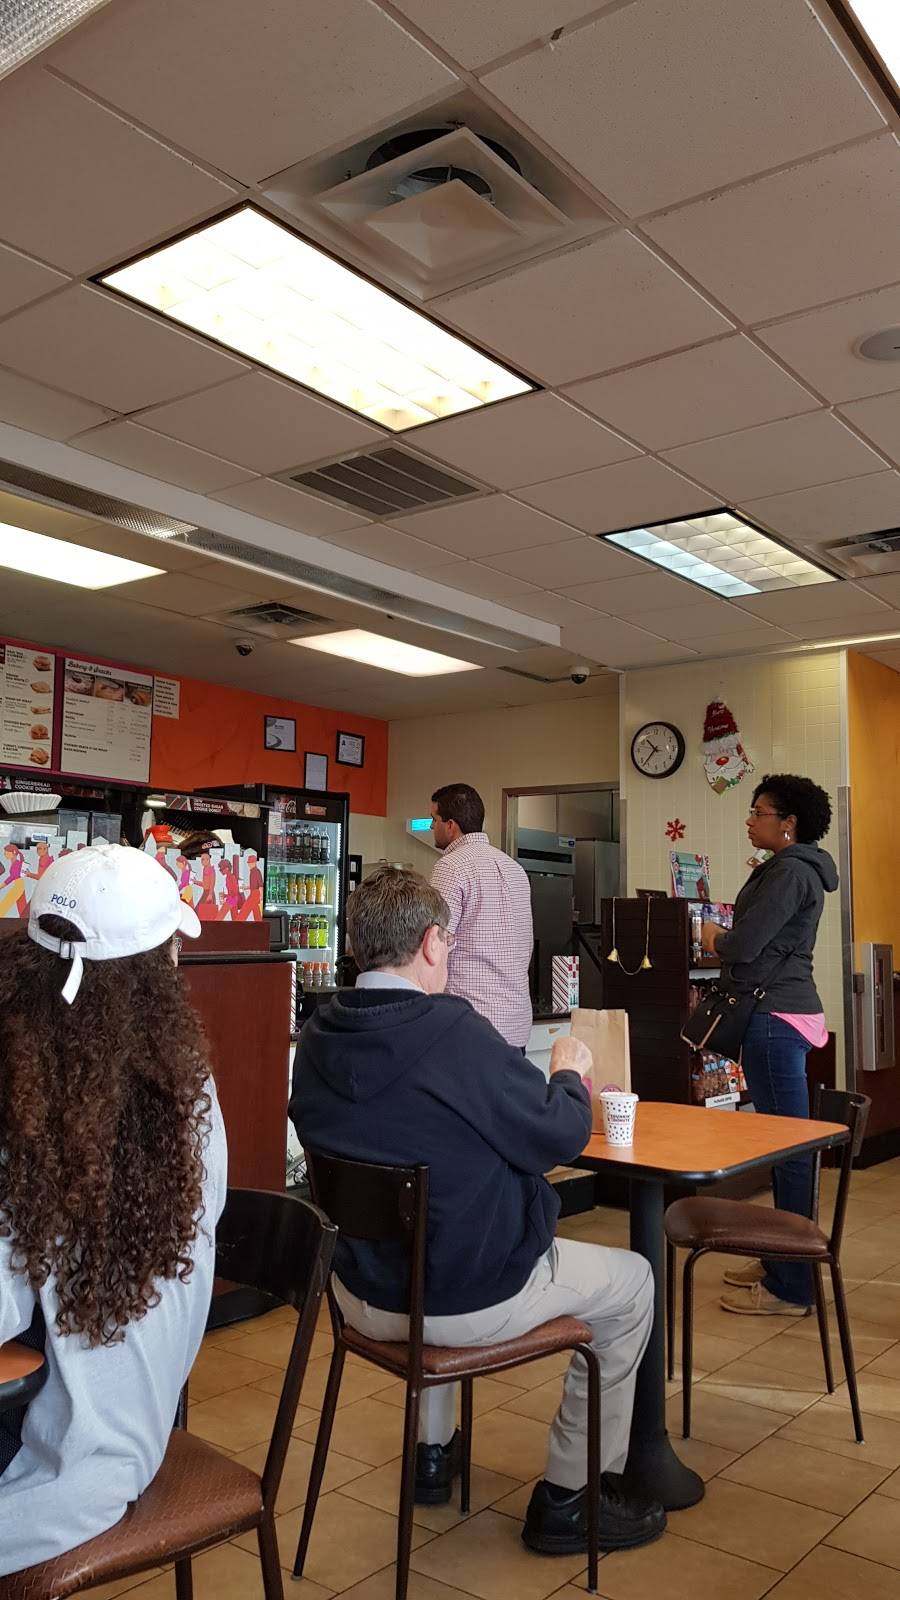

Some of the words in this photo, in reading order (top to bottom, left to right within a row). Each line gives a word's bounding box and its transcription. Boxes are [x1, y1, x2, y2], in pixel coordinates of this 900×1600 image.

[68, 661, 87, 672] Bakery
[15, 780, 51, 788] GINGERBREAD
[51, 894, 77, 909] POLO
